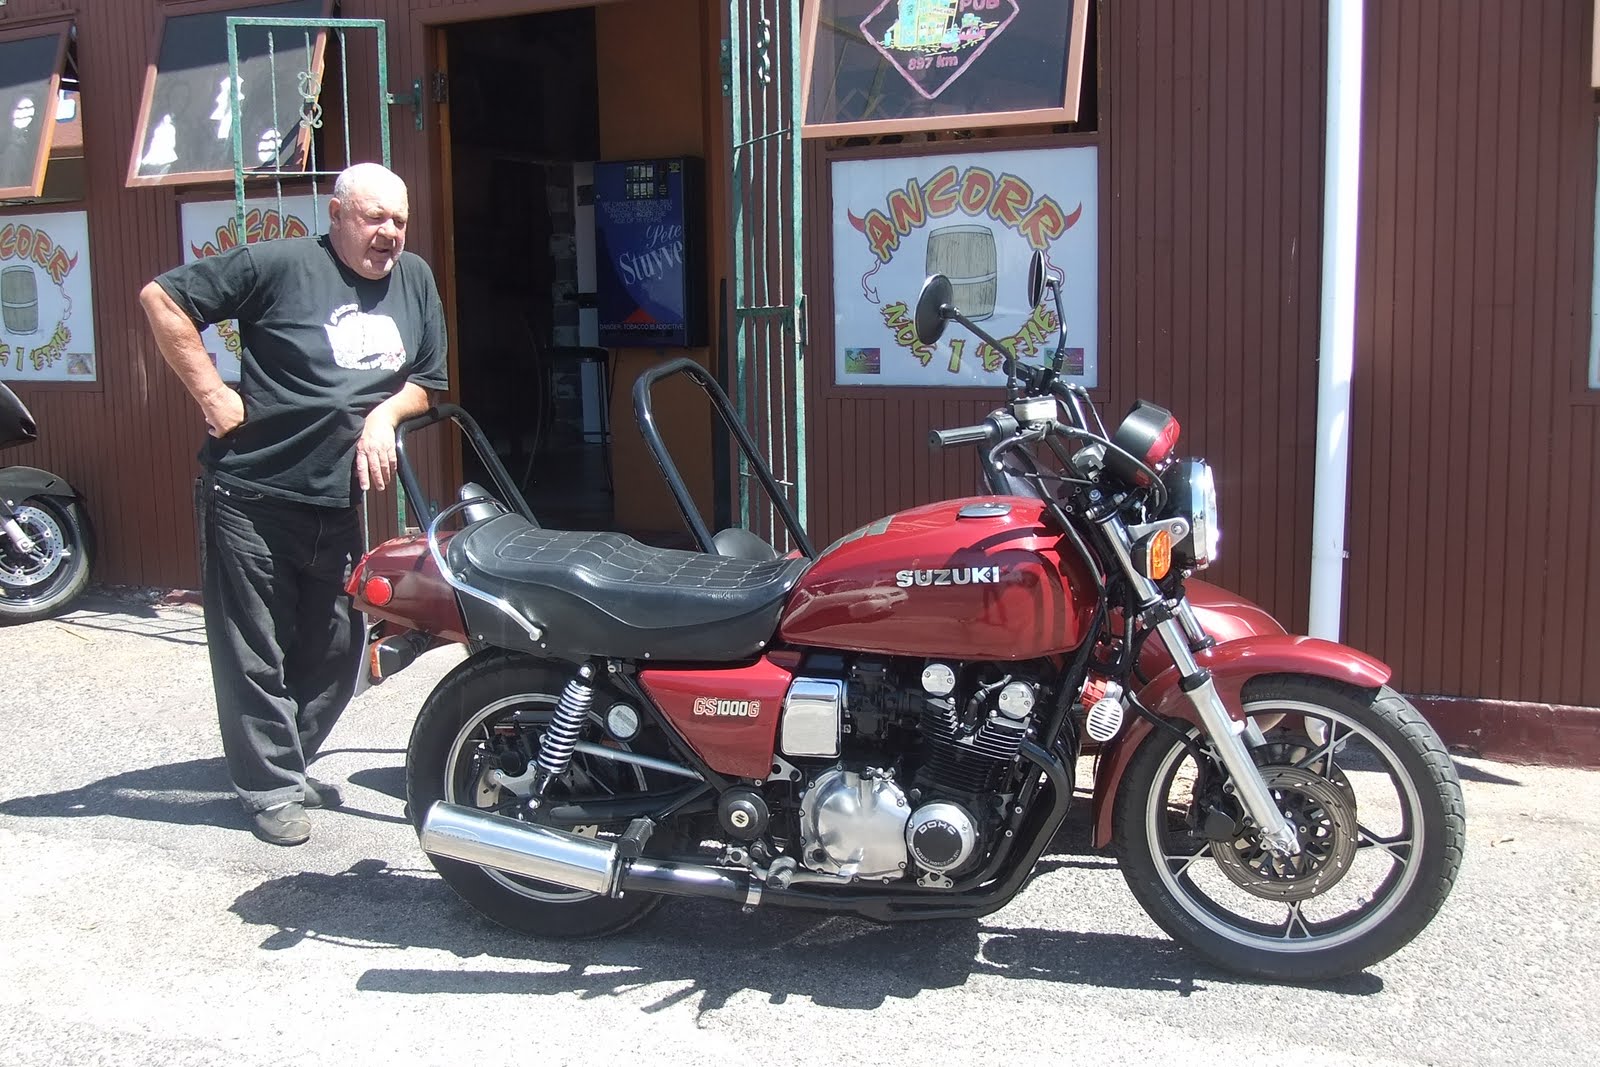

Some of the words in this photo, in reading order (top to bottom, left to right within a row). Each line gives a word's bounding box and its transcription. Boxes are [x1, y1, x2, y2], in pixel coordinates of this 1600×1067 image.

[907, 57, 933, 71] 897
[936, 54, 959, 68] km
[646, 224, 682, 249] Pete
[619, 240, 683, 285] Stuyve
[896, 566, 1000, 587] SUZUKI
[693, 697, 761, 718] GS1000G
[918, 820, 957, 835] DOHC
